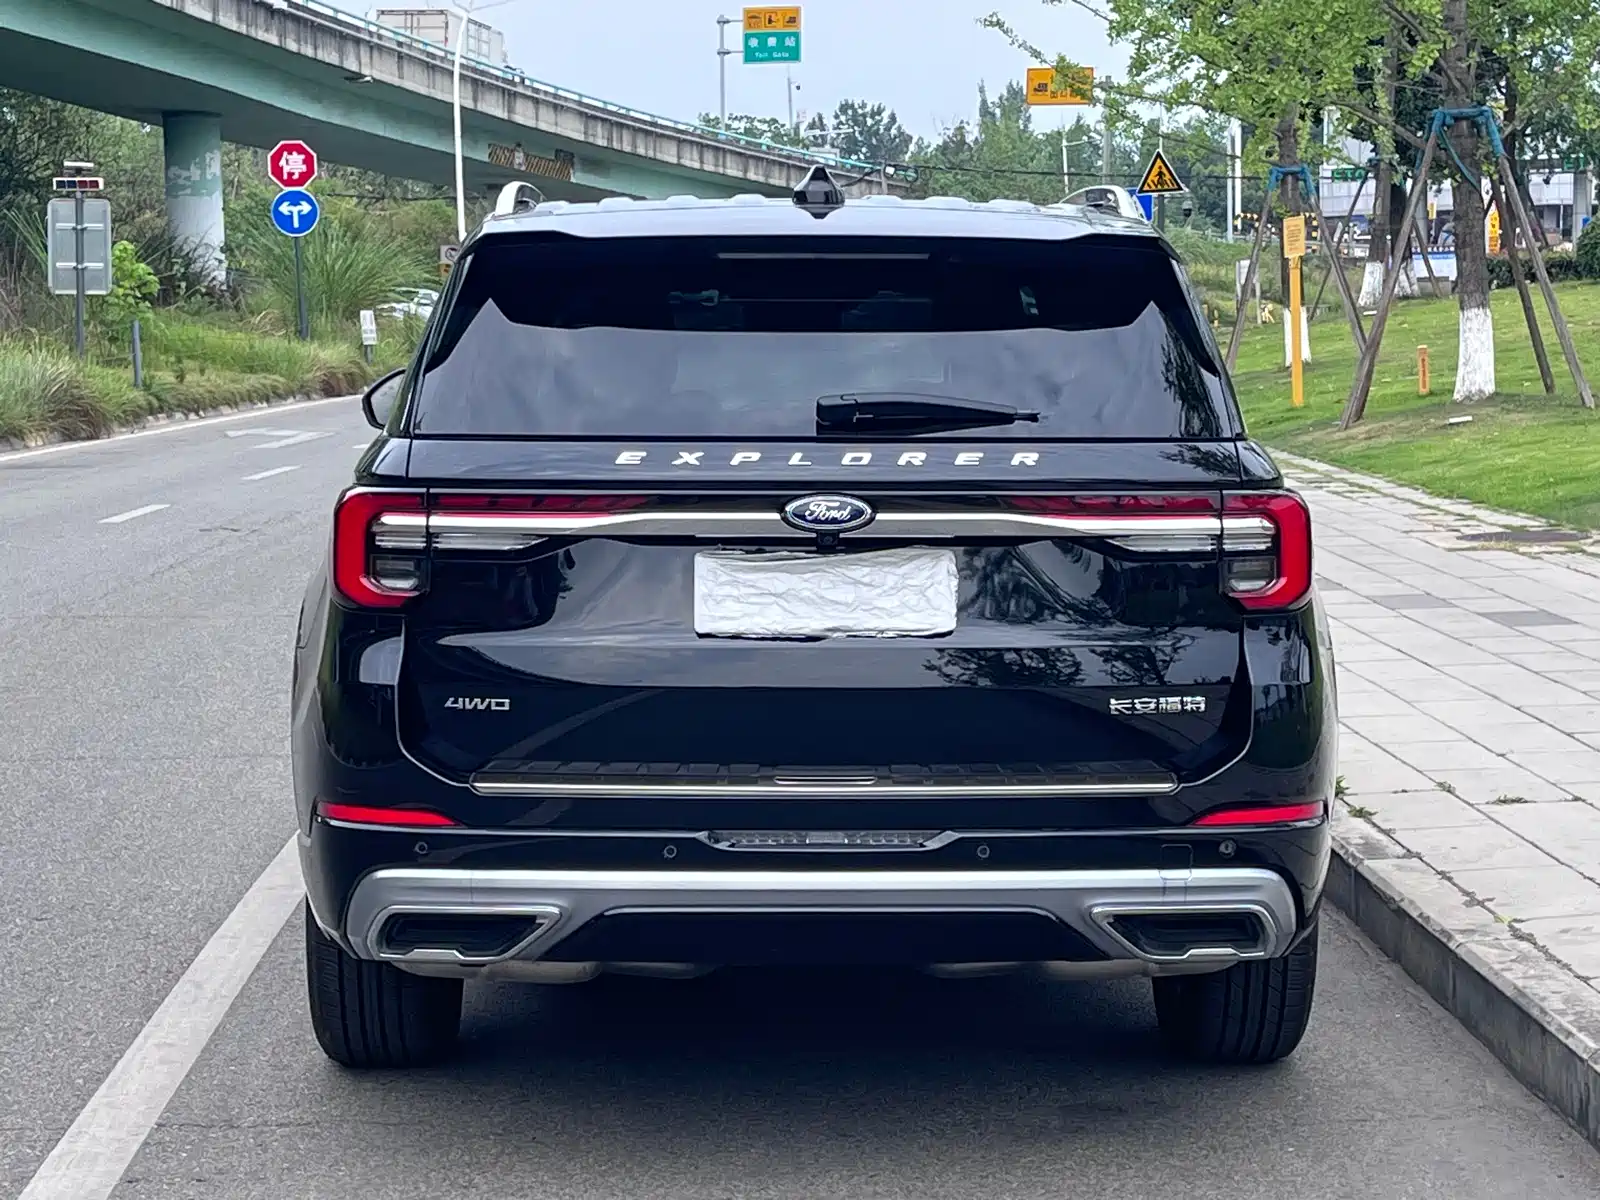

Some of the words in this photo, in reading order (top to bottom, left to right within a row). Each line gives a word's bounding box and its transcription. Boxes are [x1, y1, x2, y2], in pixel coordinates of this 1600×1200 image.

[278, 150, 307, 180] 停
[614, 451, 1040, 466] EXPLORER
[804, 501, 851, 521] Ford
[443, 697, 511, 711] 4WD
[1109, 696, 1206, 715] 长安福特
